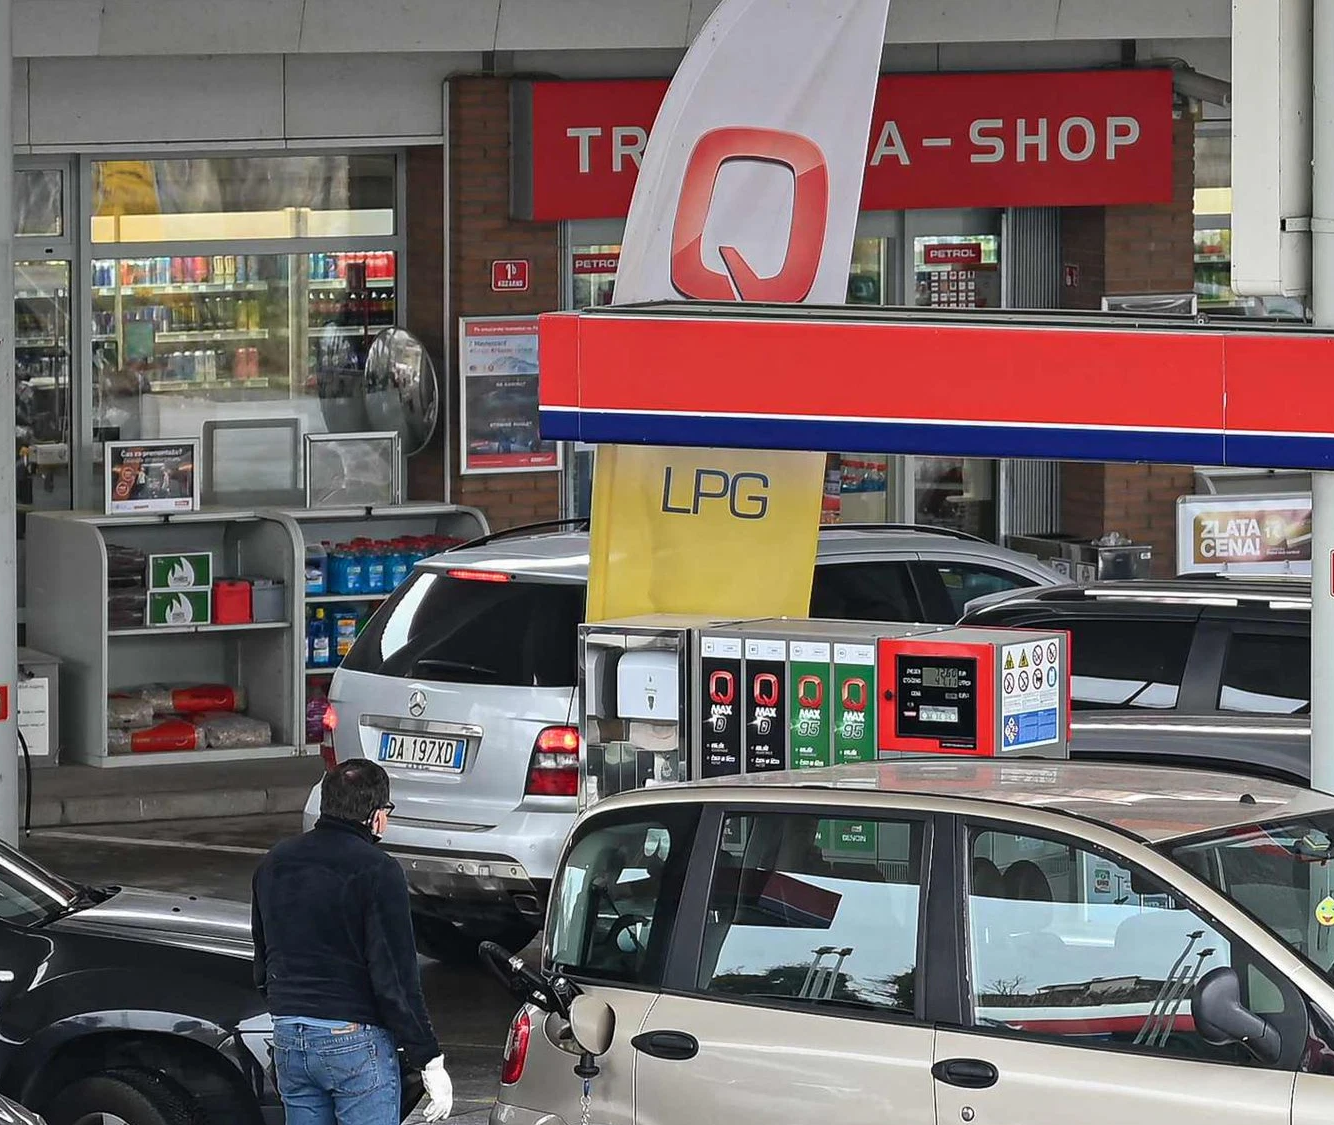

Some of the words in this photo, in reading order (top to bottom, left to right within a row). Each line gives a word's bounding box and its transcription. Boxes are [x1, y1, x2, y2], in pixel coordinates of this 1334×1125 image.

[669, 125, 831, 303] Q
[930, 248, 976, 258] PETROL
[661, 466, 770, 520] LPG
[1200, 518, 1261, 538] ZLATA
[1200, 538, 1261, 558] CENA!
[709, 671, 734, 704] Q
[753, 673, 779, 706] Q
[798, 675, 823, 709] Q
[842, 678, 867, 711] Q
[710, 705, 733, 715] MAX
[754, 707, 777, 718] MAX
[798, 709, 821, 719] MAX
[842, 711, 865, 722] MAX
[798, 720, 820, 736] 95
[842, 723, 864, 739] 95
[387, 736, 405, 760] DA
[411, 739, 454, 765] 197XD
